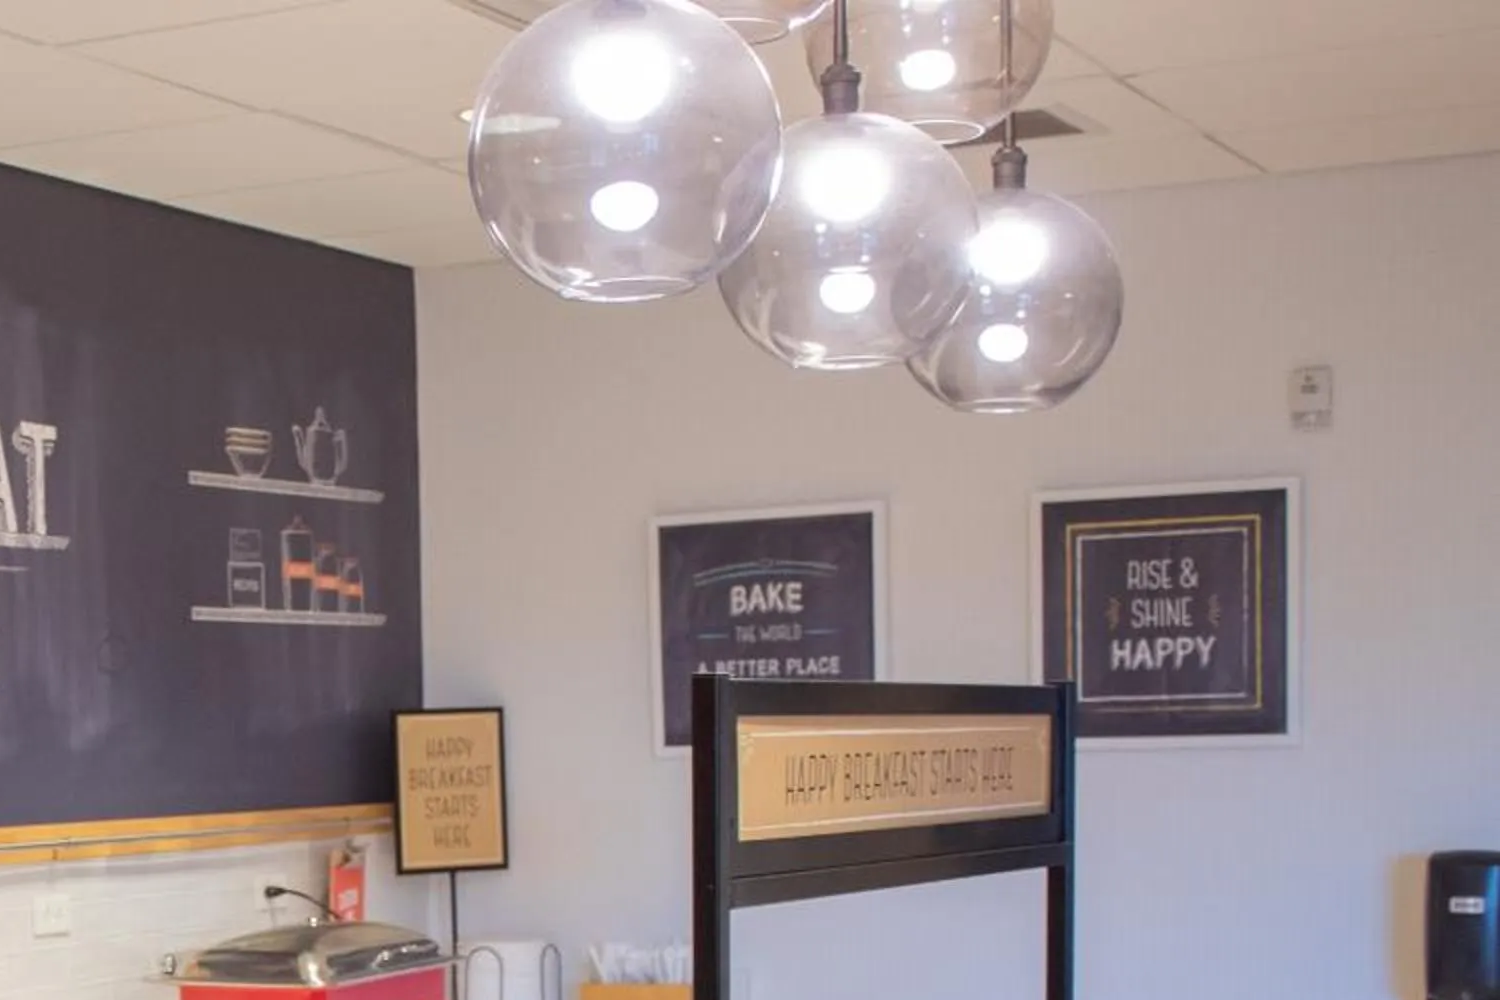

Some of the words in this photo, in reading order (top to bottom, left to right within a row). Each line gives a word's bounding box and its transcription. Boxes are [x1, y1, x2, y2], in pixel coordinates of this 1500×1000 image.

[1127, 559, 1173, 590] RISE
[1179, 557, 1199, 588] &
[729, 581, 804, 616] BAKE
[1130, 597, 1193, 629] SHINE
[760, 623, 803, 642] WORLD
[715, 657, 780, 677] BETTER
[786, 655, 841, 676] PLACE
[1110, 635, 1217, 671] HAPPY
[426, 736, 475, 761] HAPPY
[408, 764, 493, 791] BREAKFAST
[785, 752, 838, 805] HAPPY
[843, 750, 926, 801] BREAKFAST
[930, 747, 977, 797] STARTS
[424, 793, 481, 820] STARTS
[432, 823, 472, 849] HERE
